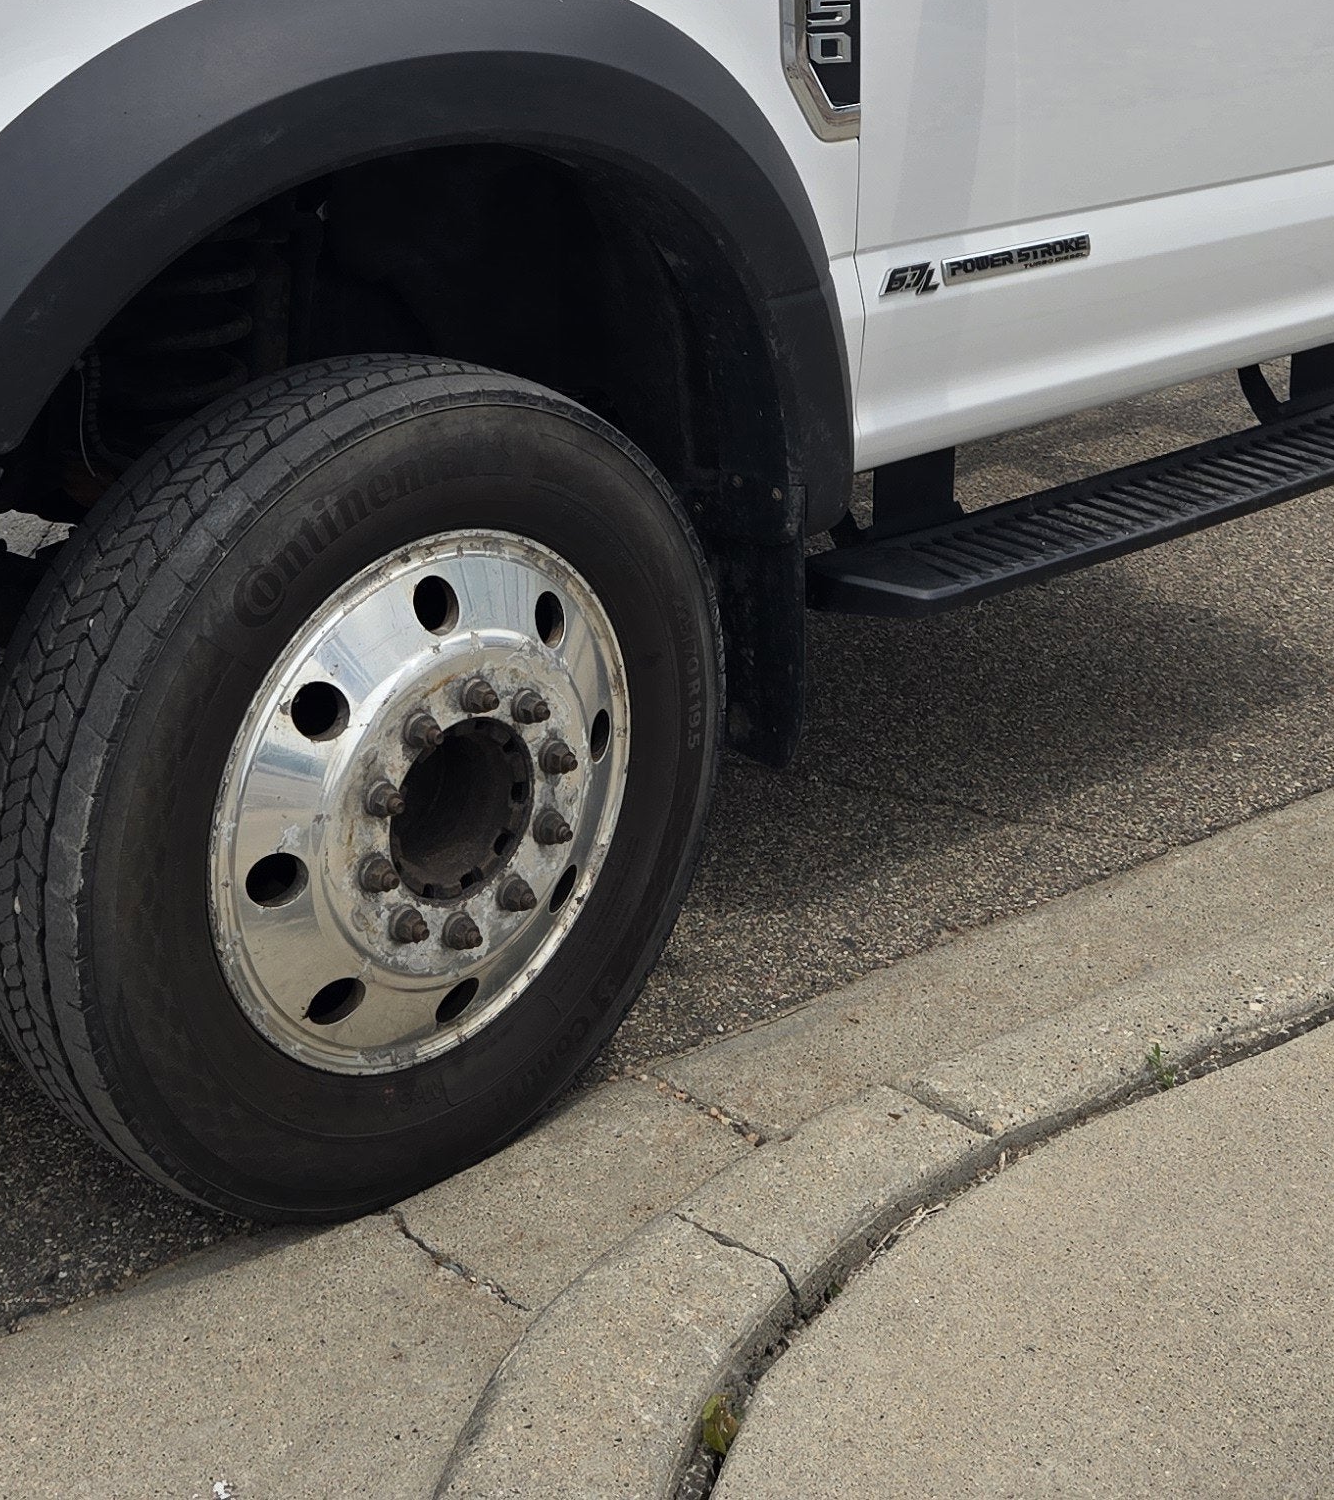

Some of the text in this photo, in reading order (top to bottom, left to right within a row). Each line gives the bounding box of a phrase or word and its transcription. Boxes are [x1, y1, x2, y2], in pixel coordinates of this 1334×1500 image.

[949, 250, 1014, 276] POWER
[1017, 235, 1088, 263] STROKE
[1023, 252, 1087, 269] TURBO DIESEL
